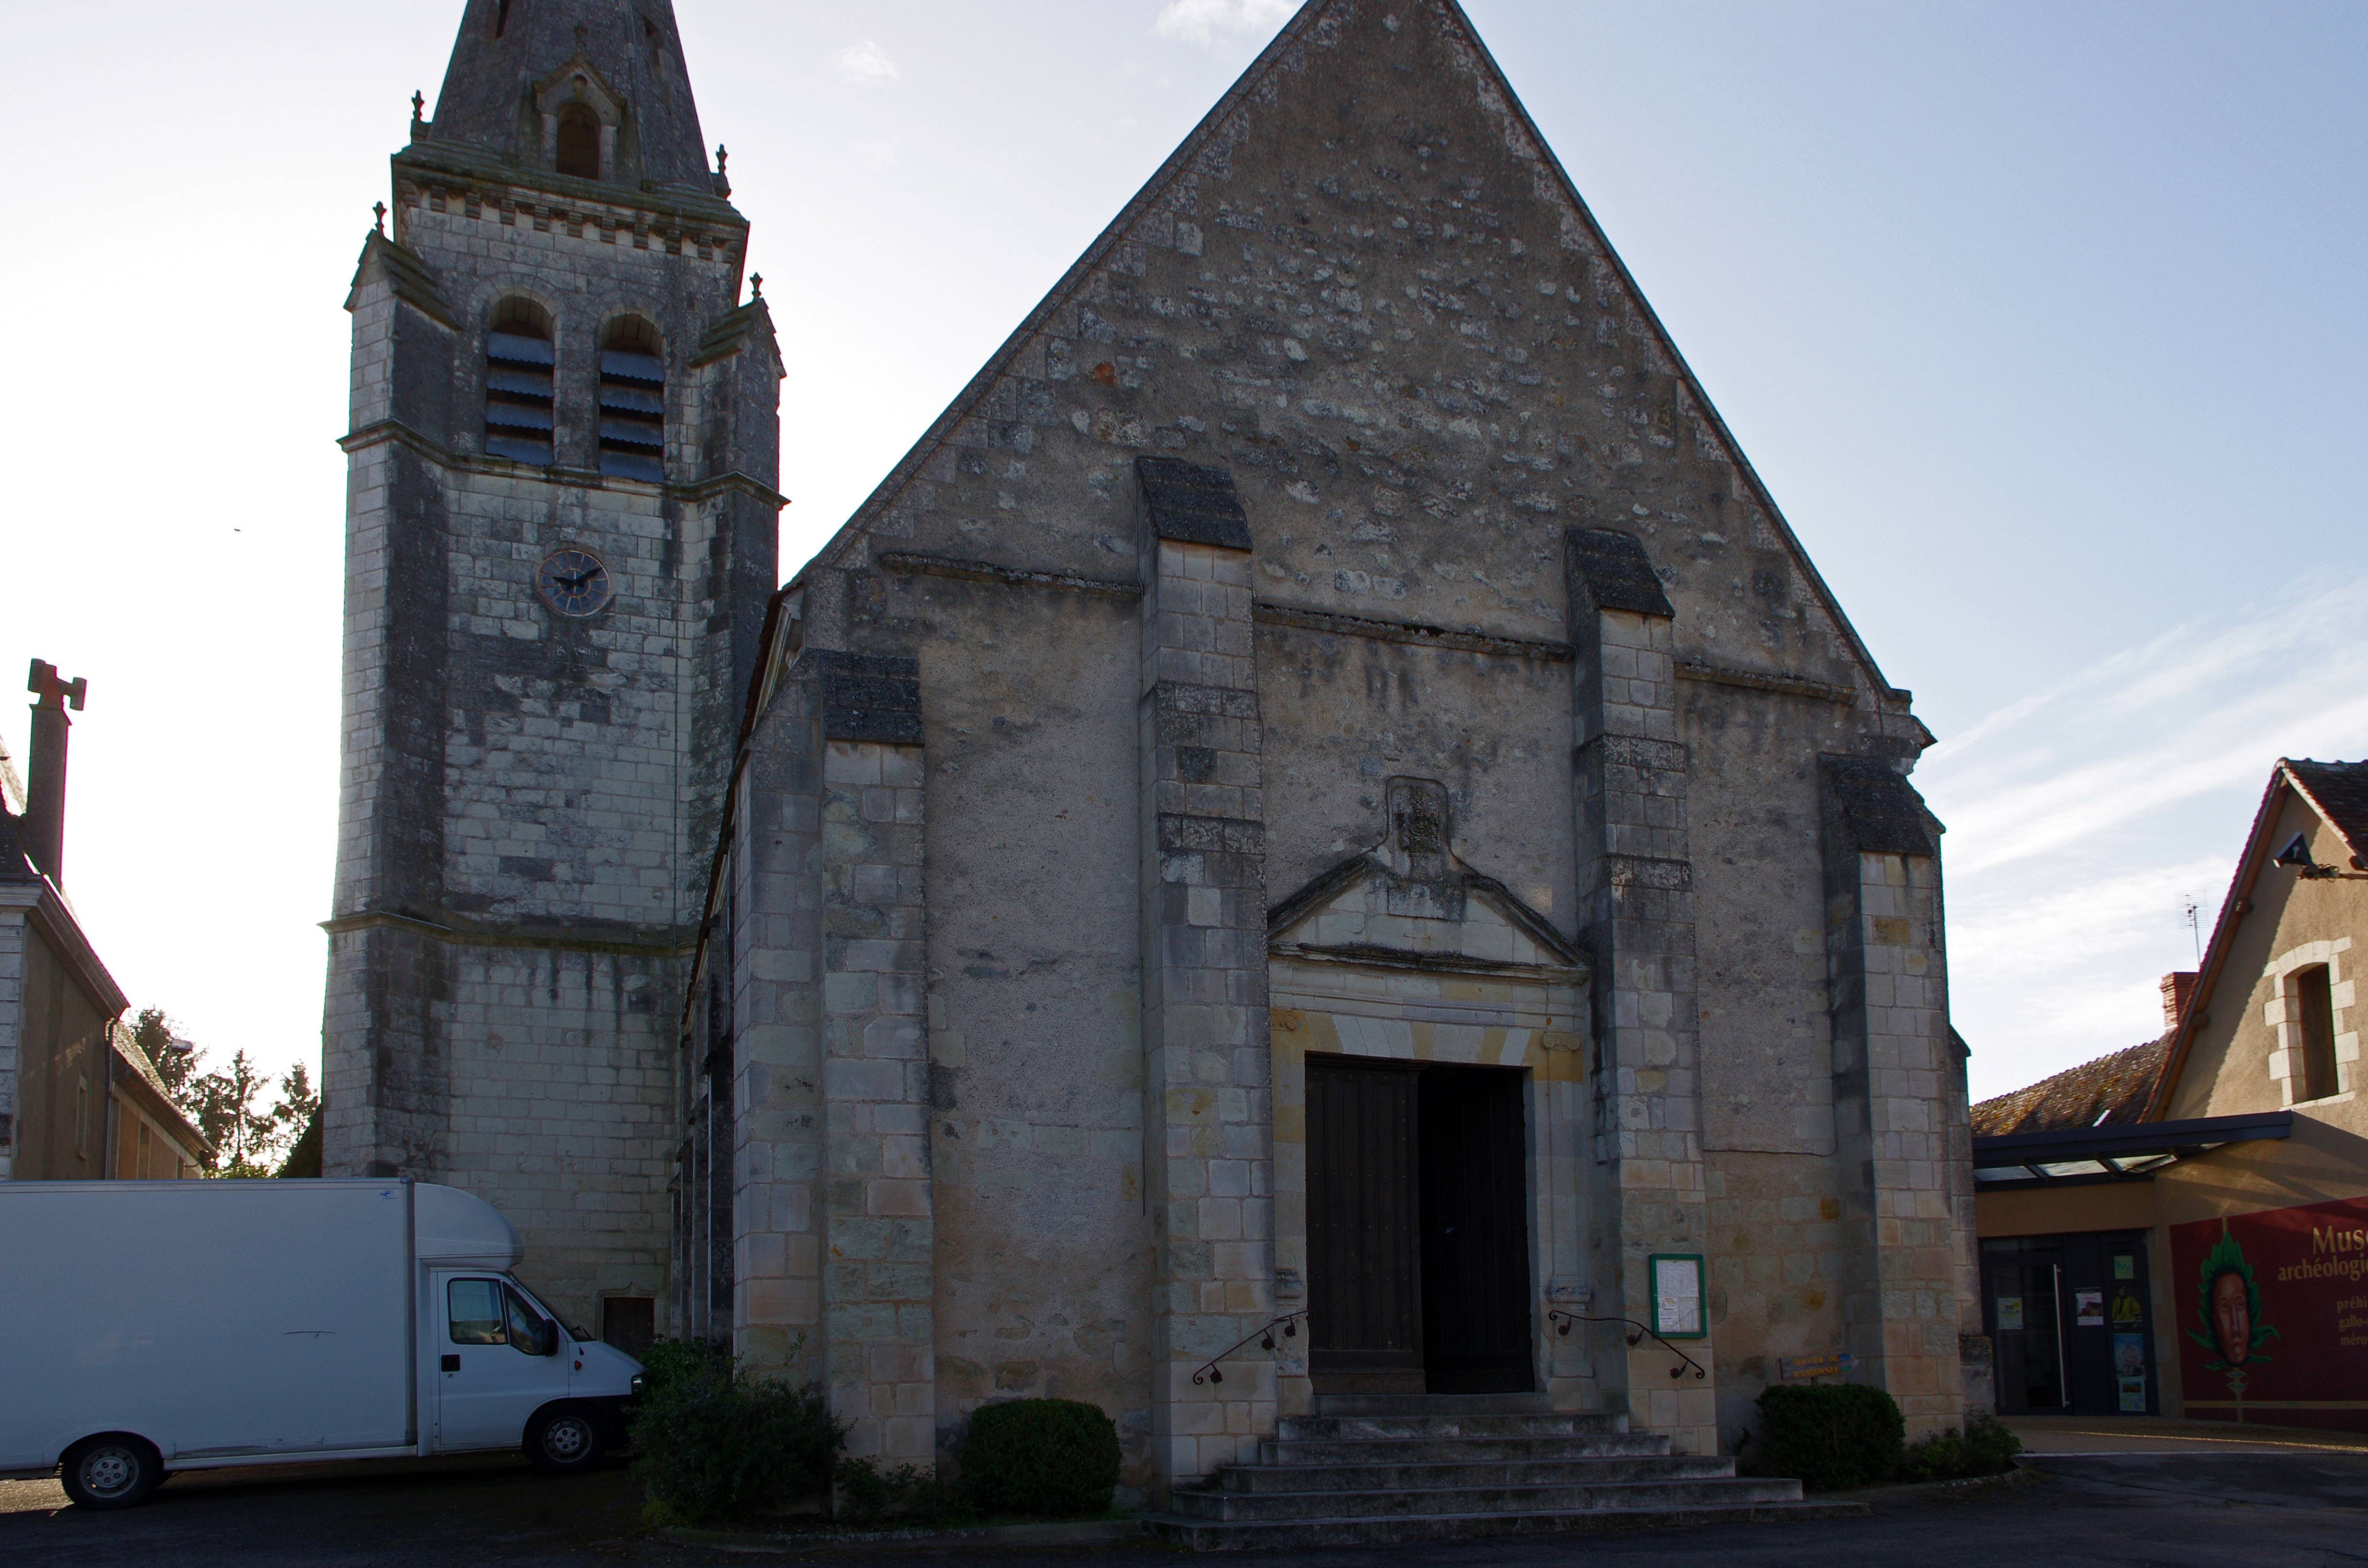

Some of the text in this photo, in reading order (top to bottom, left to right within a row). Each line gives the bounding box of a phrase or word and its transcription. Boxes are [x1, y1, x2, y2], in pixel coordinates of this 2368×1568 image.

[2313, 1225, 2368, 1254] Mus
[2278, 1253, 2368, 1281] archéologi
[2337, 1295, 2368, 1314] préhi
[2338, 1314, 2368, 1332] gallo-
[2340, 1332, 2368, 1346] méro
[1794, 1357, 1824, 1366] SENTIER
